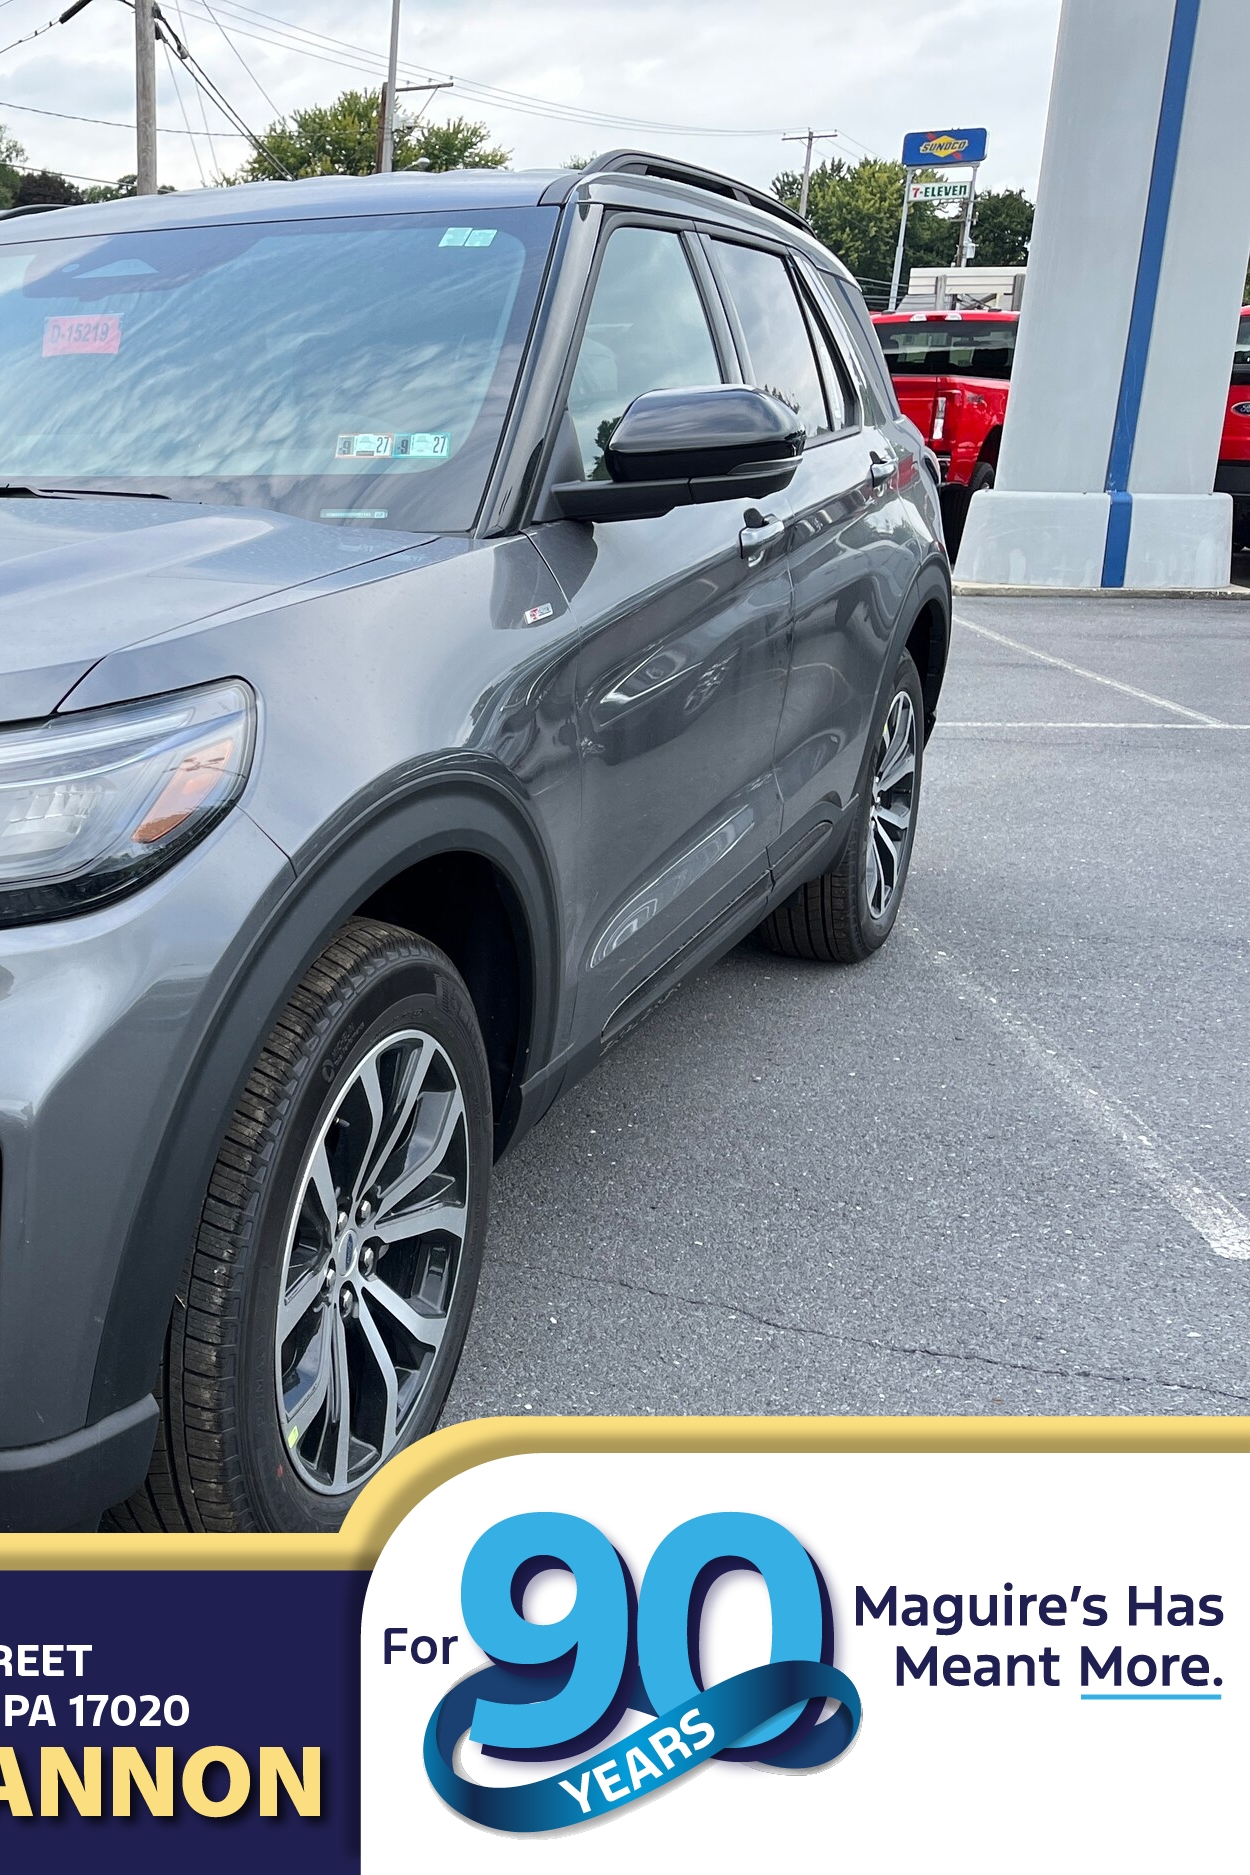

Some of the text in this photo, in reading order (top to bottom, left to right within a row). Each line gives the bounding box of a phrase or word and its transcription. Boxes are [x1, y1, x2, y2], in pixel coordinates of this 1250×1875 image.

[921, 140, 967, 152] SUNOCO
[51, 322, 110, 344] D-15219
[376, 436, 390, 454] 27
[433, 436, 447, 454] 27
